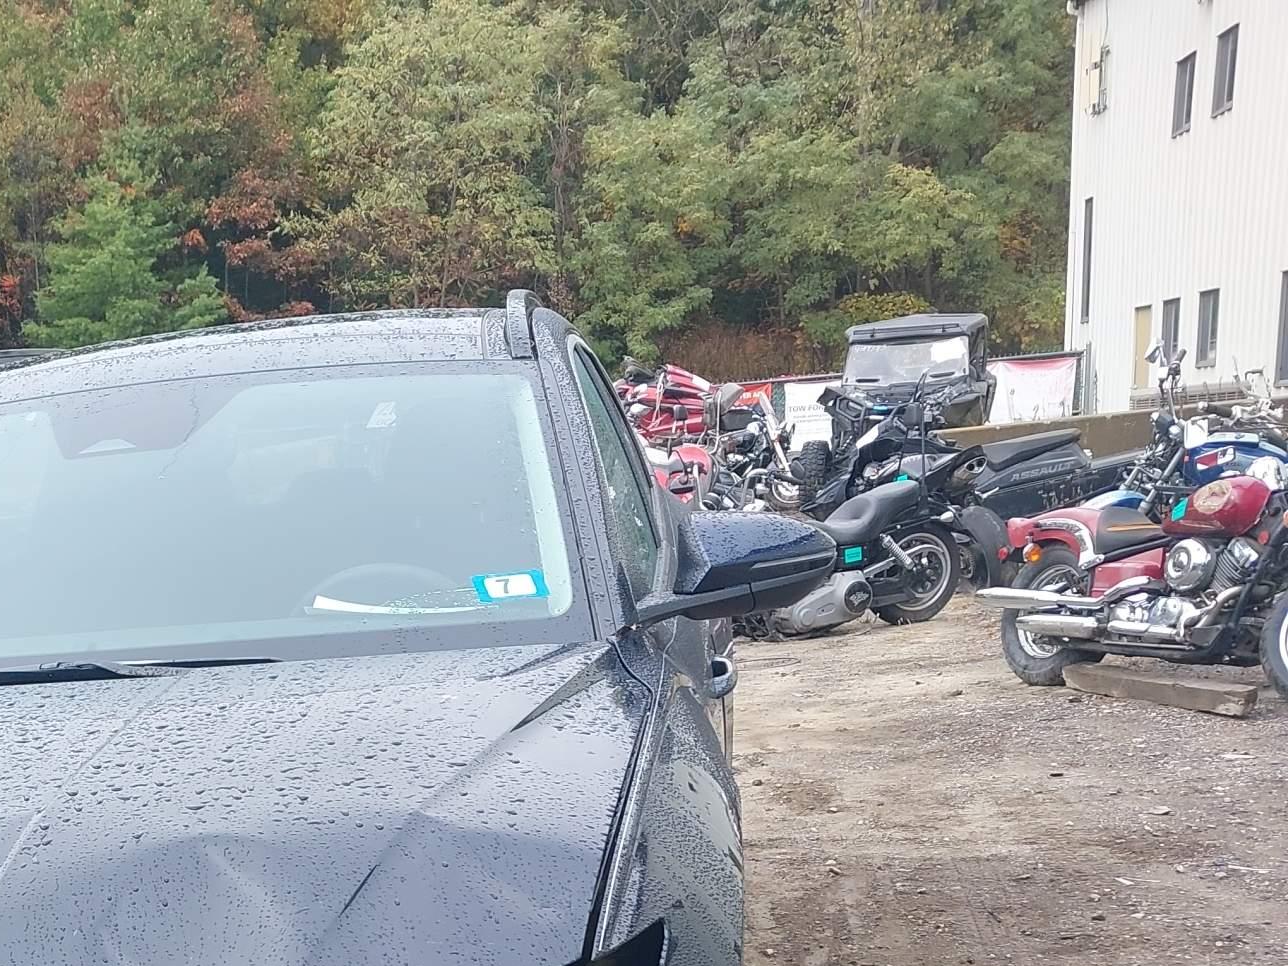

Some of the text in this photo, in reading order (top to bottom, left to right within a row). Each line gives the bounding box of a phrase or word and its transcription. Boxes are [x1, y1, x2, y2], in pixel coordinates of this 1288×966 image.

[789, 405, 806, 413] TOW
[1010, 461, 1074, 481] ASSAULT
[495, 579, 510, 594] 7
